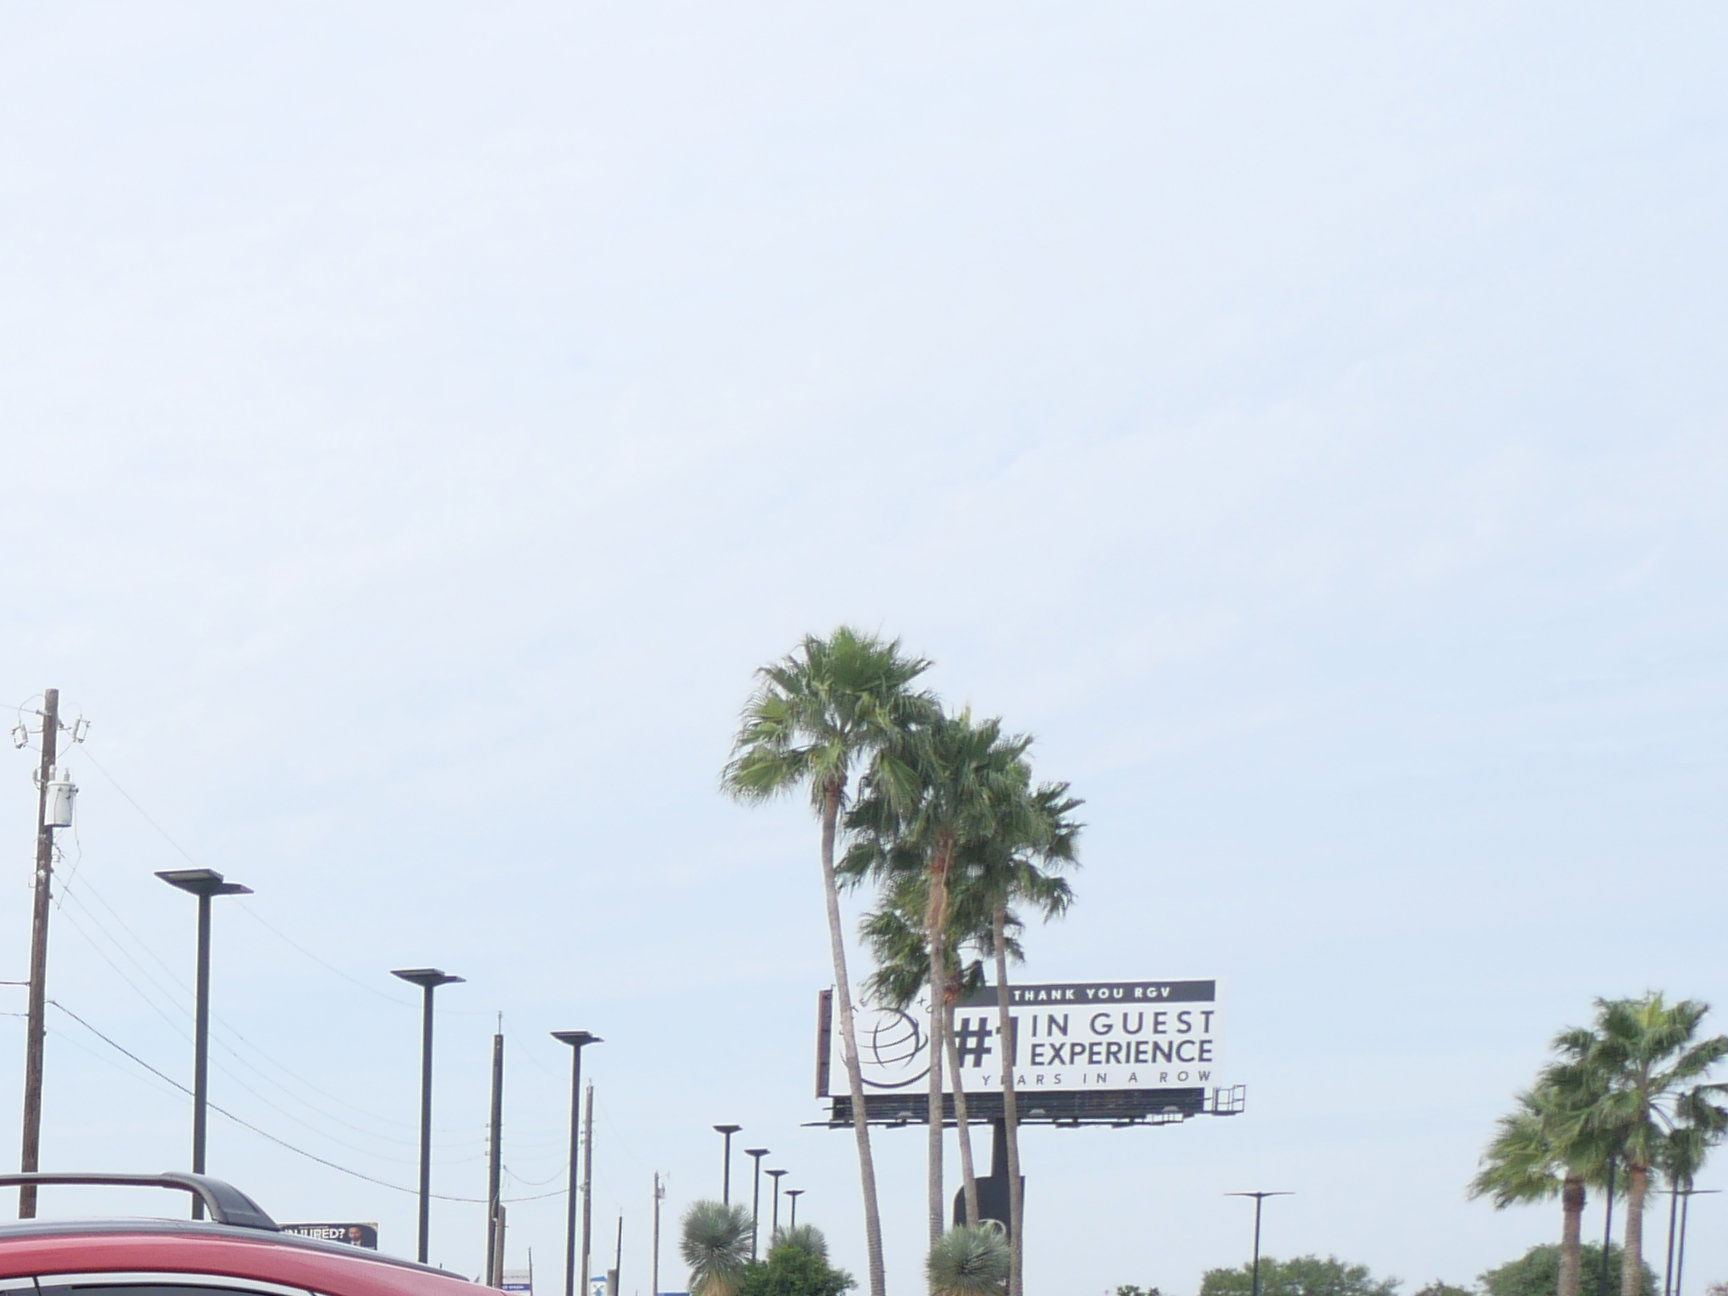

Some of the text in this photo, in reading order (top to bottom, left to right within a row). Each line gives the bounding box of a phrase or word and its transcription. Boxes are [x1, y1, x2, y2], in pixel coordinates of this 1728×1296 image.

[1013, 987, 1171, 1001] THANK YOU RGV
[1031, 1010, 1214, 1038] IN GUEST
[1030, 1039, 1214, 1066] EXPERIENCE
[1082, 1072, 1107, 1084] IN
[1128, 1072, 1138, 1083] A
[1159, 1070, 1211, 1084] ROW
